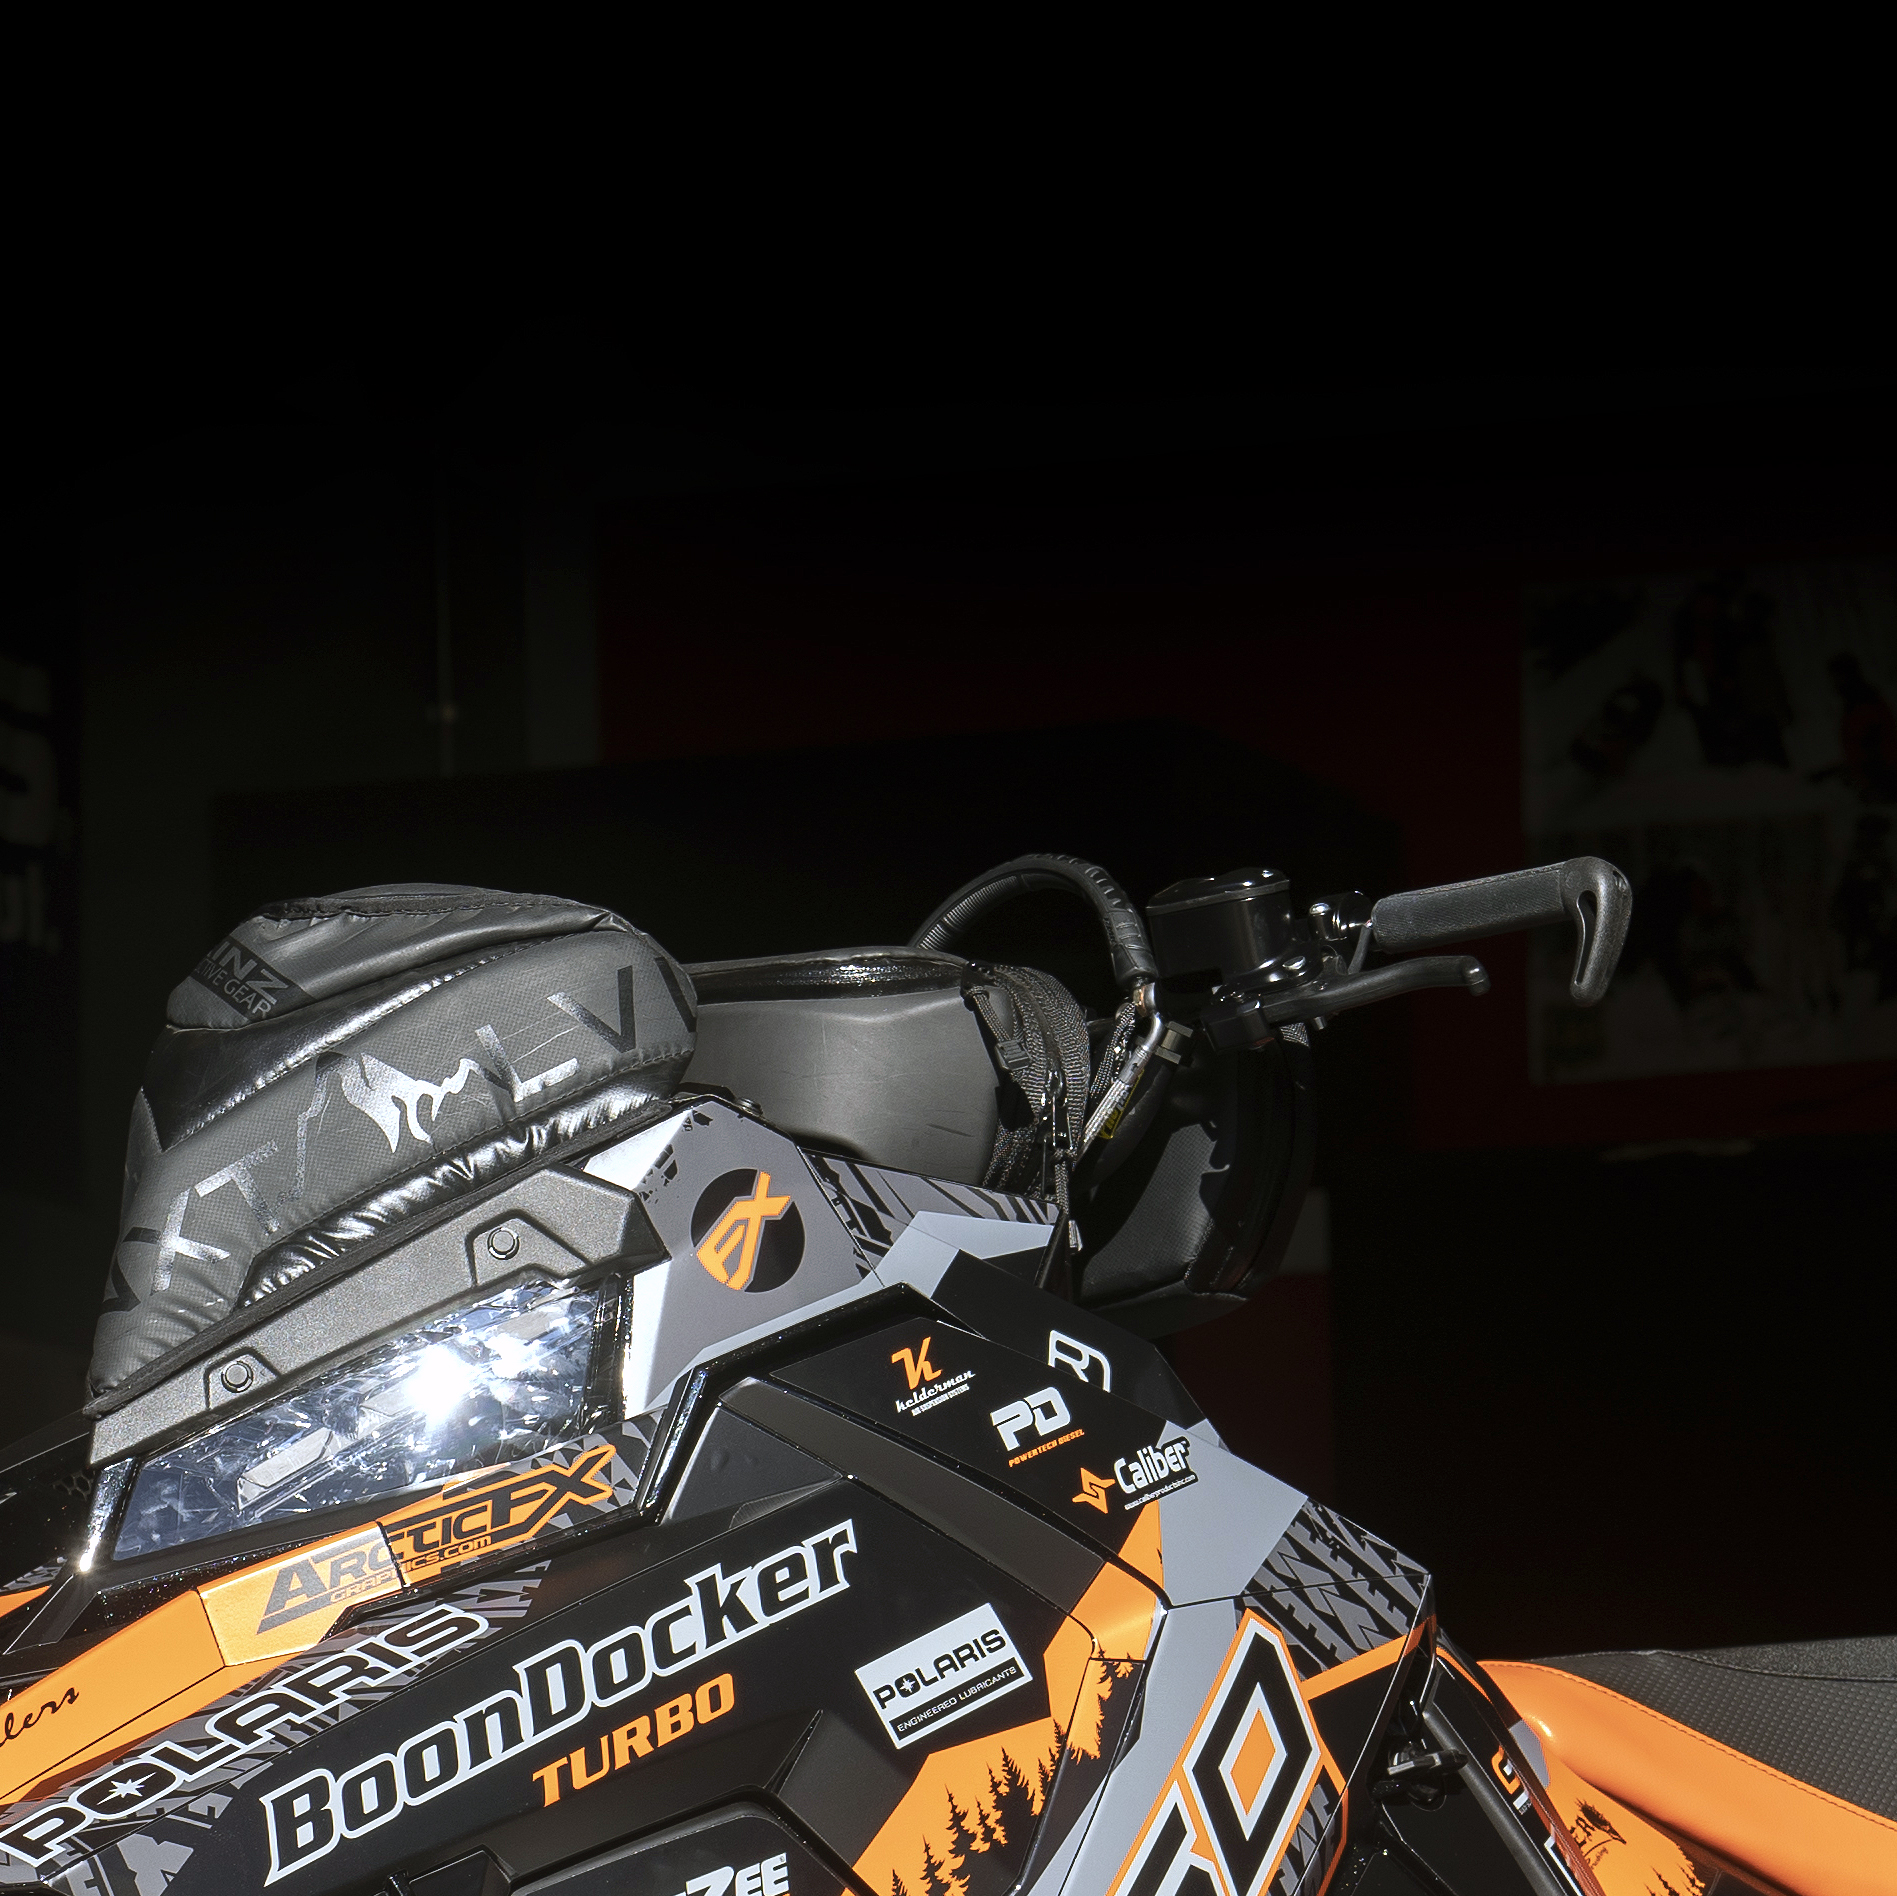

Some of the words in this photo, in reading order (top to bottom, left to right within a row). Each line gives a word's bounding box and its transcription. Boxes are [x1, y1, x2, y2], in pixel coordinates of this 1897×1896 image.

[1114, 1442, 1187, 1494] Caliber
[264, 1518, 857, 1887] BoonDocker
[872, 1628, 1007, 1710] POLARIS
[897, 1697, 958, 1732] ENGINEERED
[958, 1666, 1018, 1700] LUBRICANTS
[532, 1673, 736, 1807] TURBO
